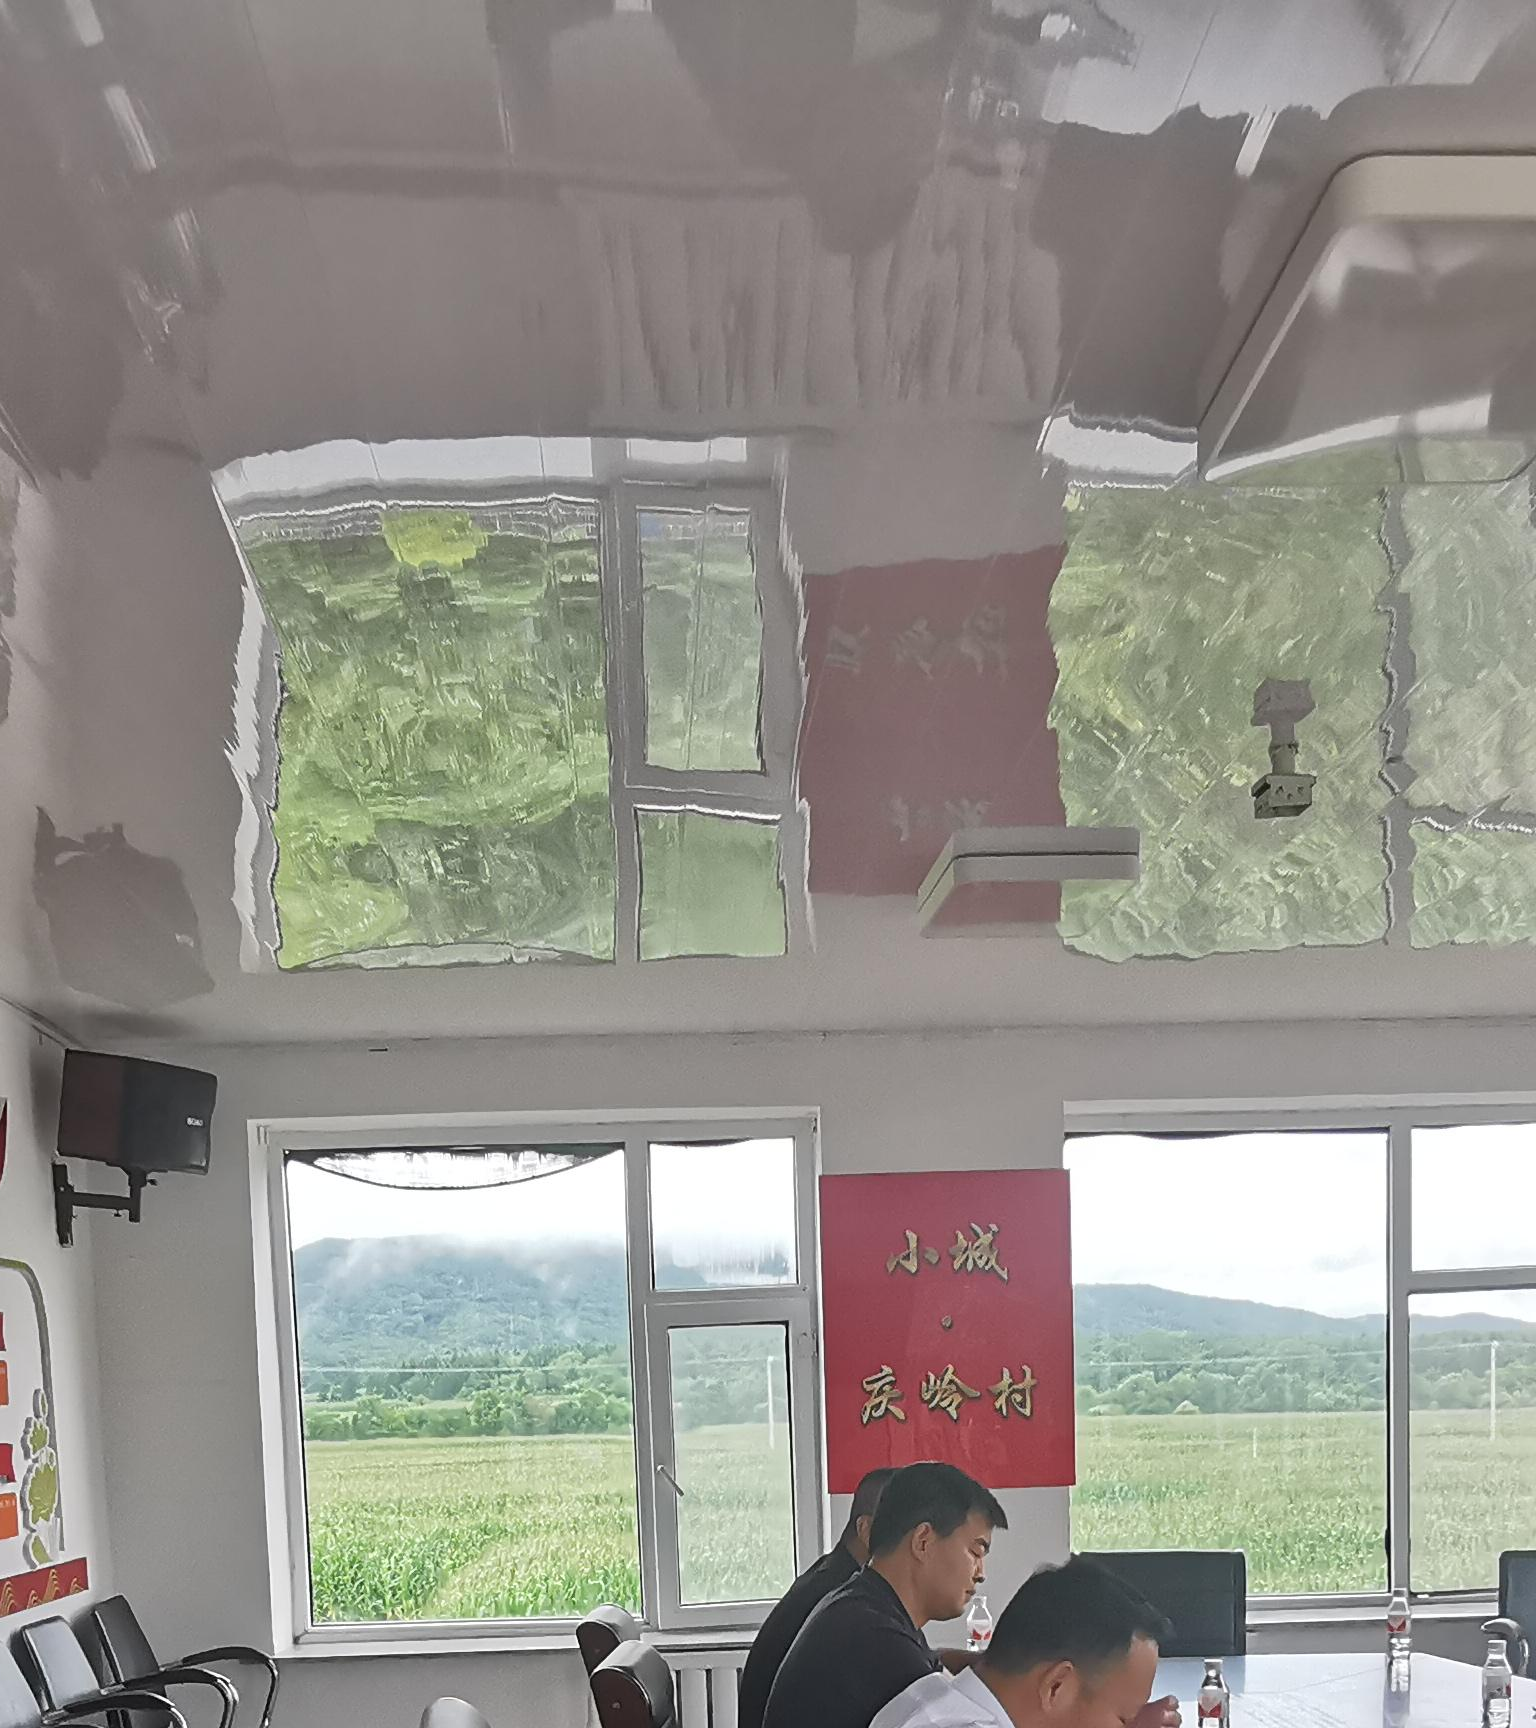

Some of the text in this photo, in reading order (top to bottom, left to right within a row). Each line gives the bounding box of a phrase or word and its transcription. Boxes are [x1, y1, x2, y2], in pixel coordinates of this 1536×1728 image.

[886, 1222, 1008, 1282] 小城
[861, 1364, 1038, 1424] 庆岭村
